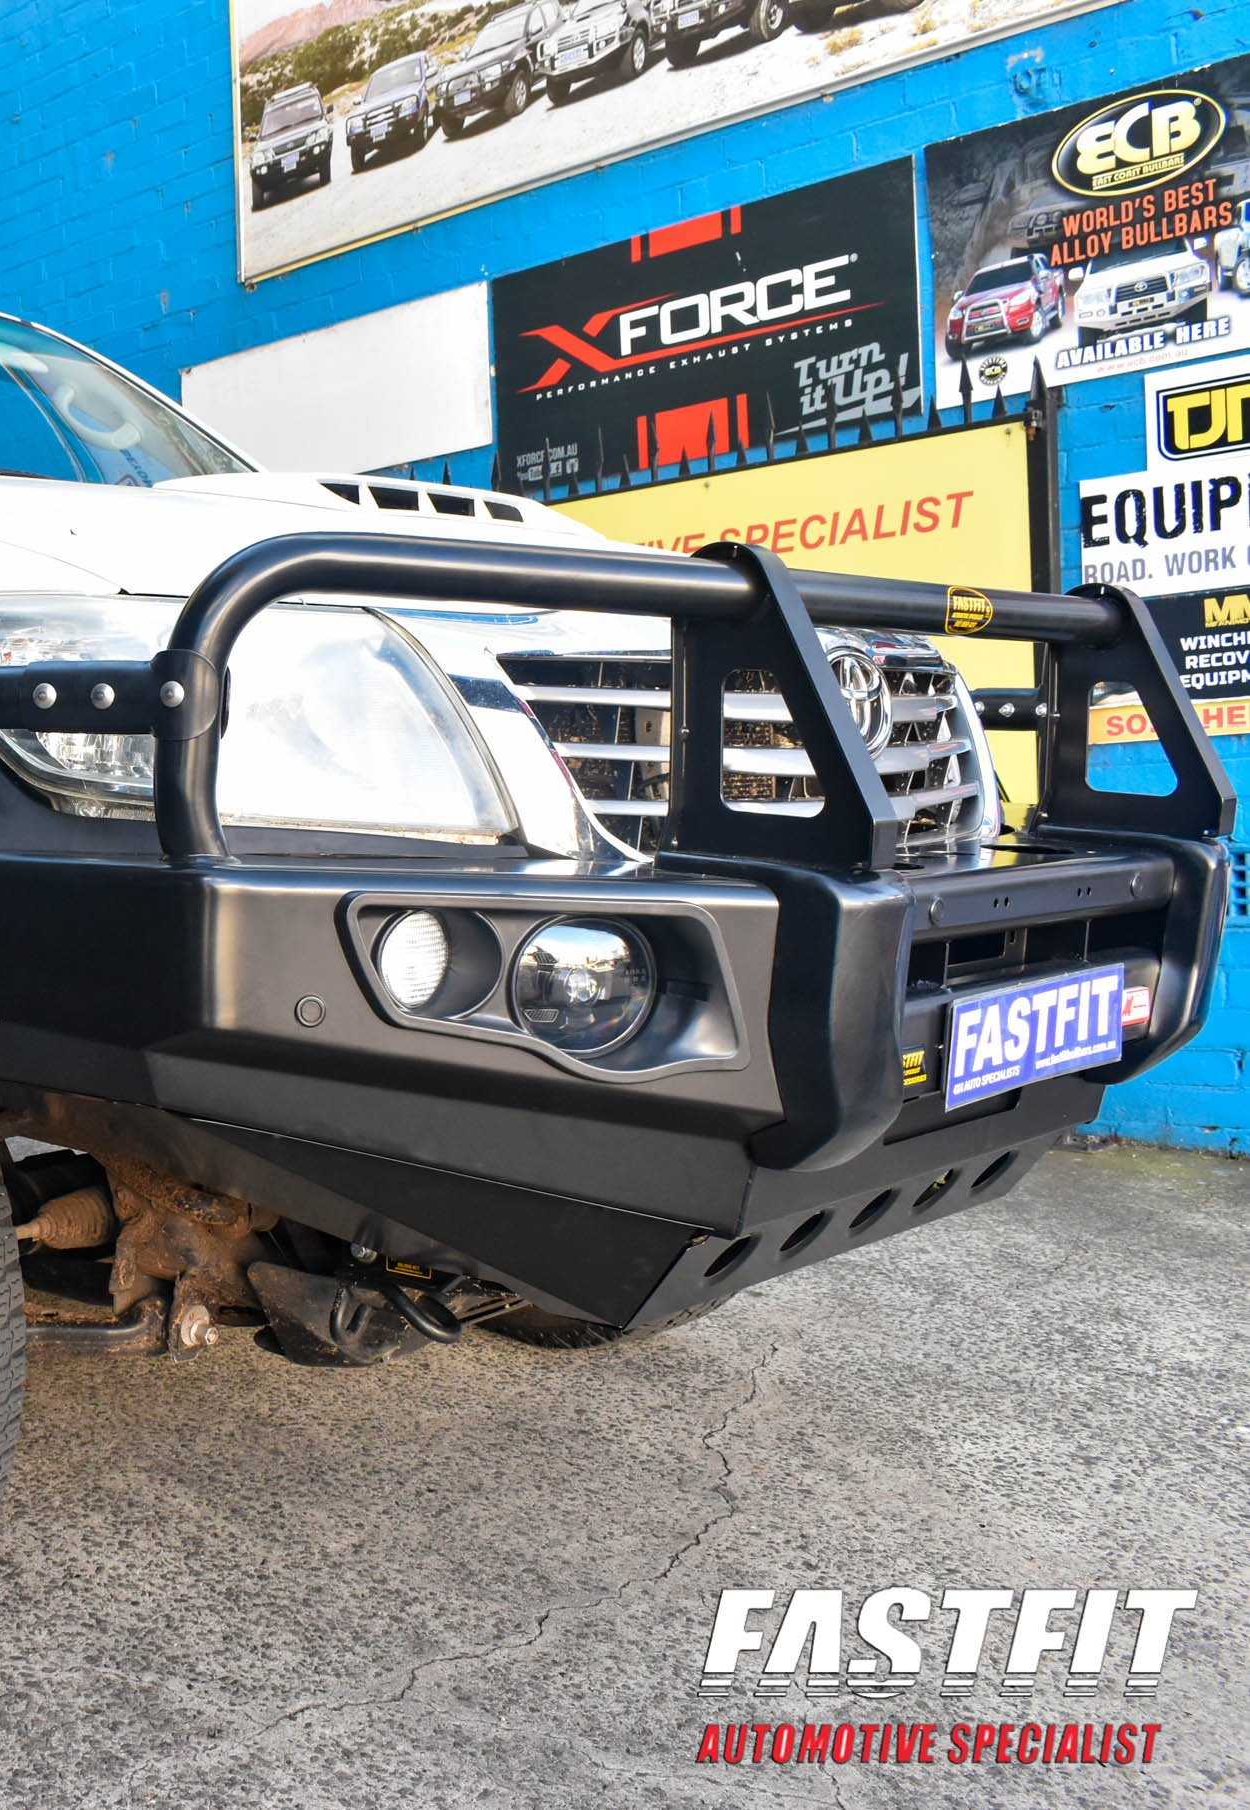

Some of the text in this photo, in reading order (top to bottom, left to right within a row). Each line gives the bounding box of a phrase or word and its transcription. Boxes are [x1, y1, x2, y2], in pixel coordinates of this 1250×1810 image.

[1076, 101, 1202, 175] ECB
[1113, 167, 1142, 182] COAST
[1142, 156, 1185, 173] BULLBARS
[1050, 201, 1233, 267] ALLOY BULLBARS
[1062, 178, 1217, 238] WORLD'S BEST
[517, 254, 852, 394] XFORCE
[1056, 316, 1231, 369] AVAILABLE HERE
[536, 318, 854, 400] PERFORMANCE EXHAUST SYSTEMS
[794, 341, 886, 388] Turn
[800, 383, 828, 416] it
[1081, 475, 1250, 549] EQUIP
[1084, 545, 1237, 585] ROAD. WORK
[1179, 631, 1250, 652] WINCH
[953, 974, 1120, 1079] FASTFIT
